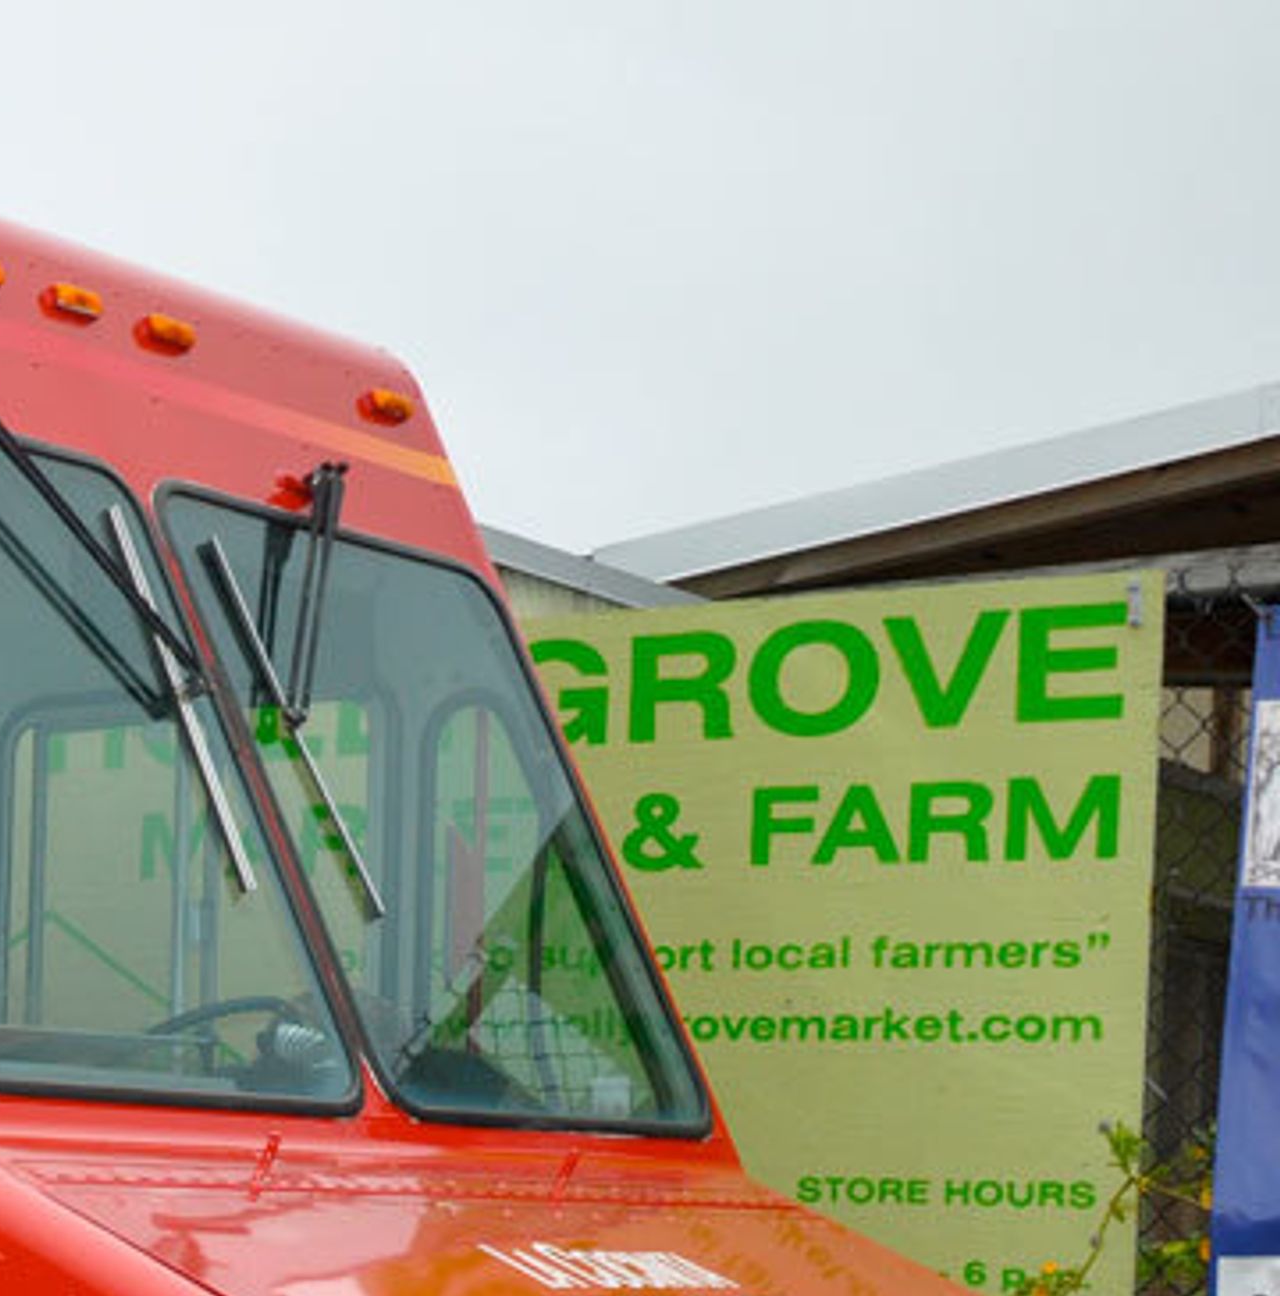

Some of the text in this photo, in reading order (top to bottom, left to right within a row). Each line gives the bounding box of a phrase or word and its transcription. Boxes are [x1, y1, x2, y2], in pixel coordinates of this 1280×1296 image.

[622, 792, 705, 873] &
[750, 774, 1122, 867] FARM
[731, 935, 852, 971] local
[796, 1175, 1097, 1210] STORE HOURS
[963, 1259, 987, 1288] 6
